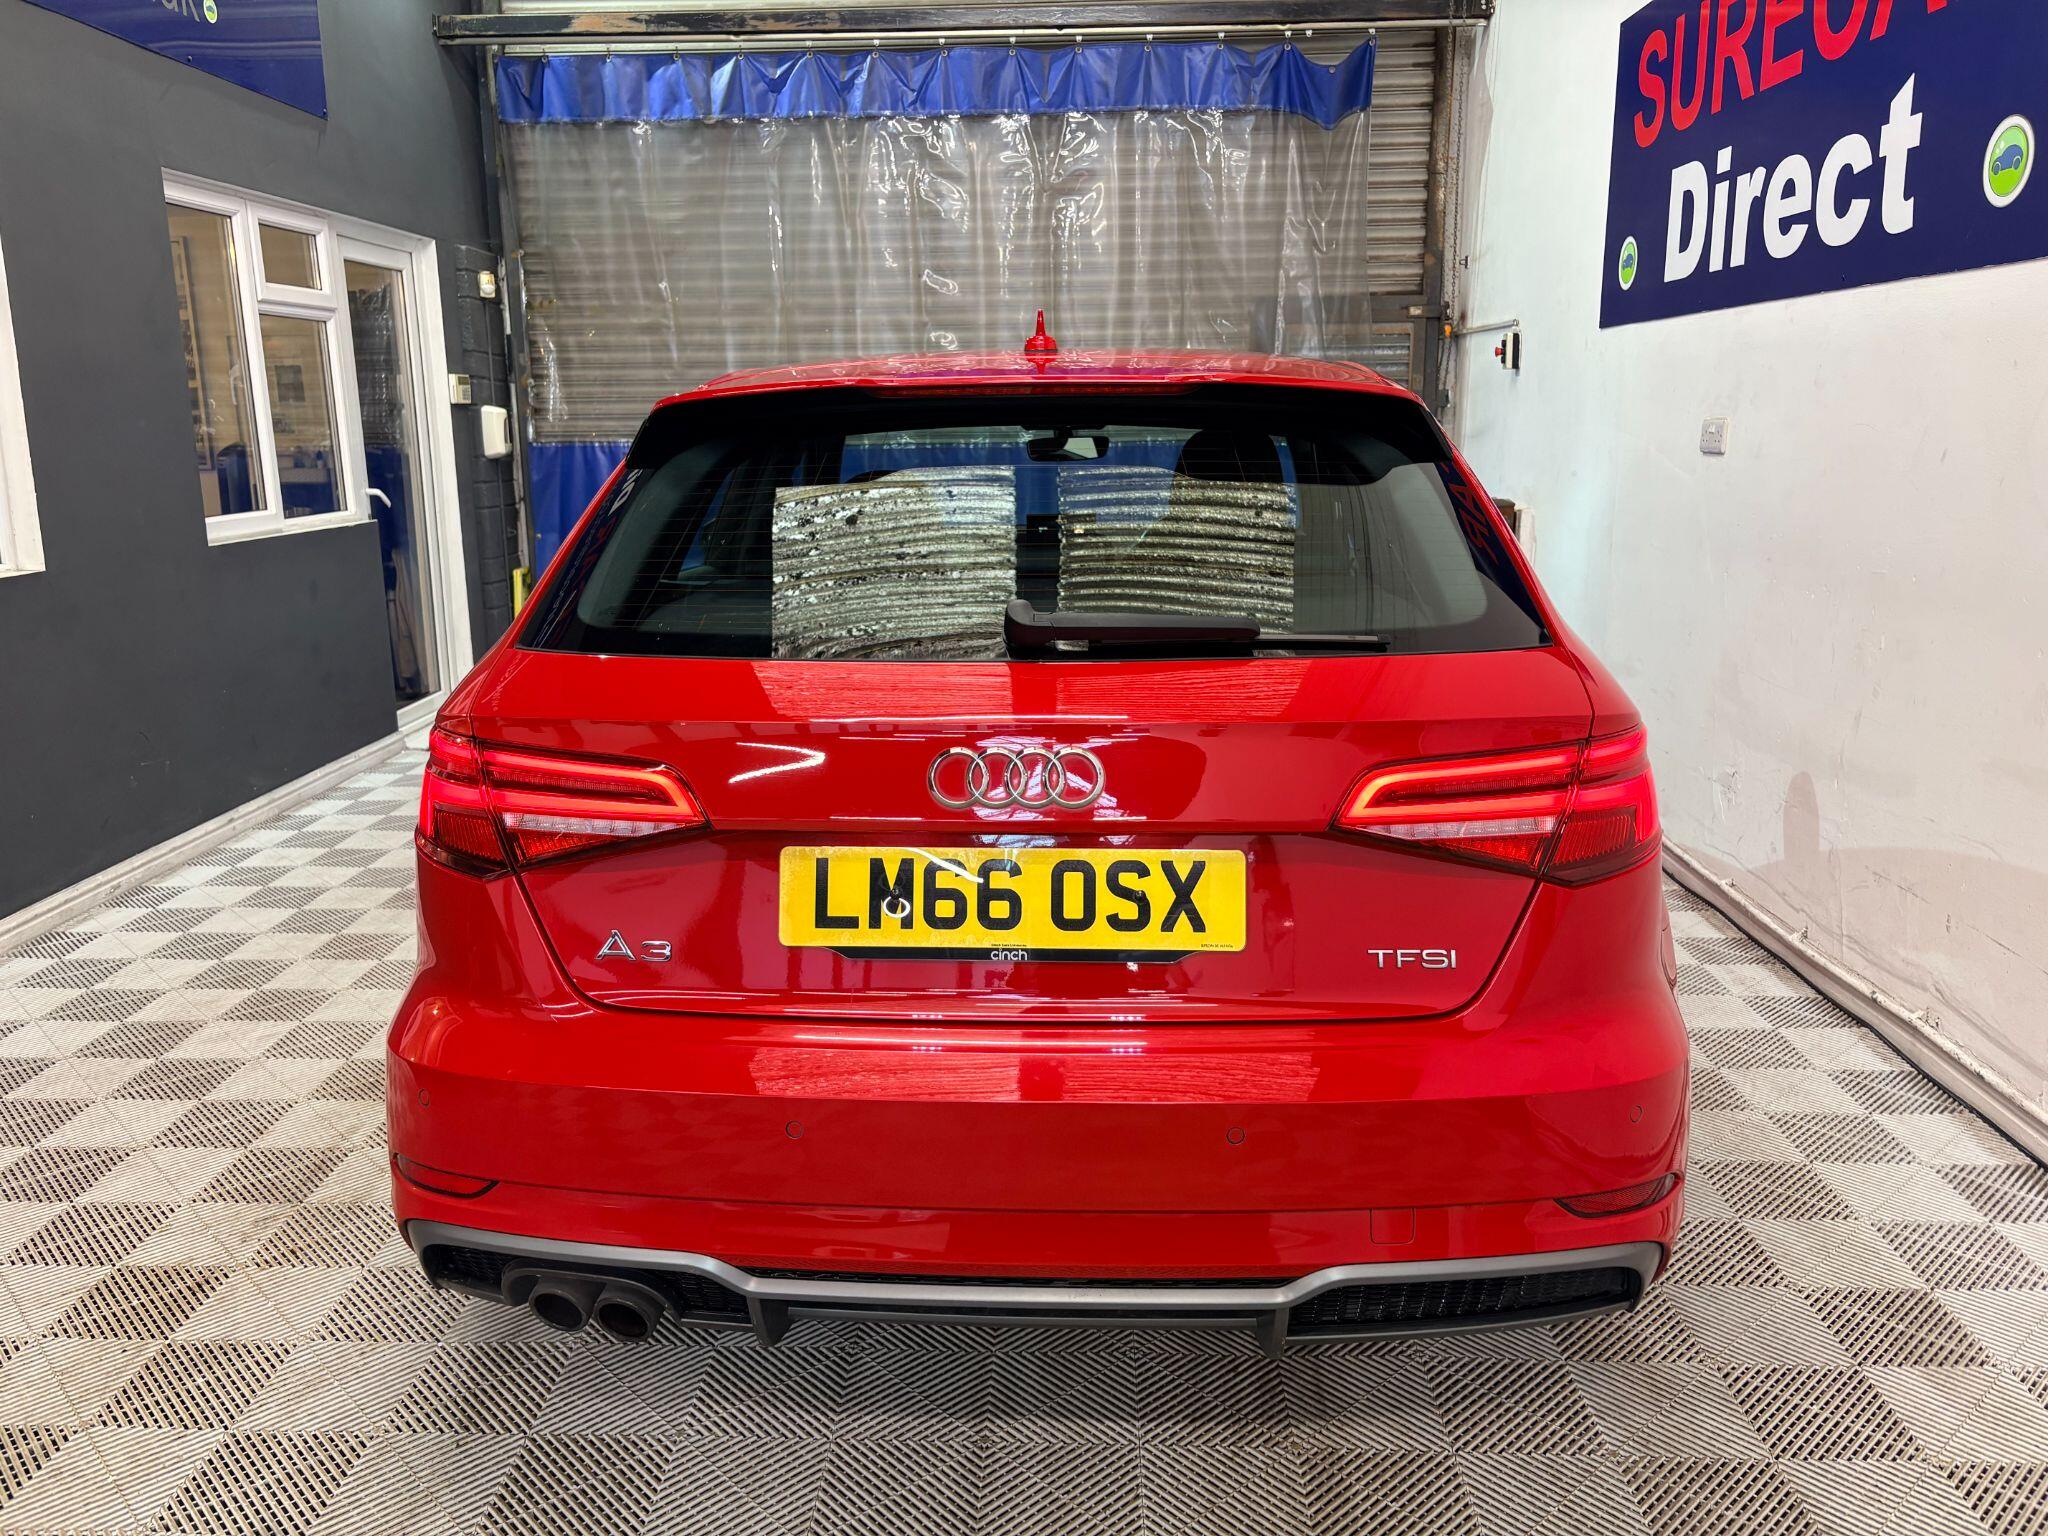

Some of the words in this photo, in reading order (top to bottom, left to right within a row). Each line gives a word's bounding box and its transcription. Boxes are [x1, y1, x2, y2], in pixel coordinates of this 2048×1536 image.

[1634, 0, 1947, 147] SURE
[1664, 72, 1923, 282] Direct
[814, 857, 1024, 931] LM66
[1050, 859, 1207, 933] OSX
[595, 929, 672, 962] A3
[990, 947, 1028, 961] cinch
[1366, 949, 1457, 969] TFSI
